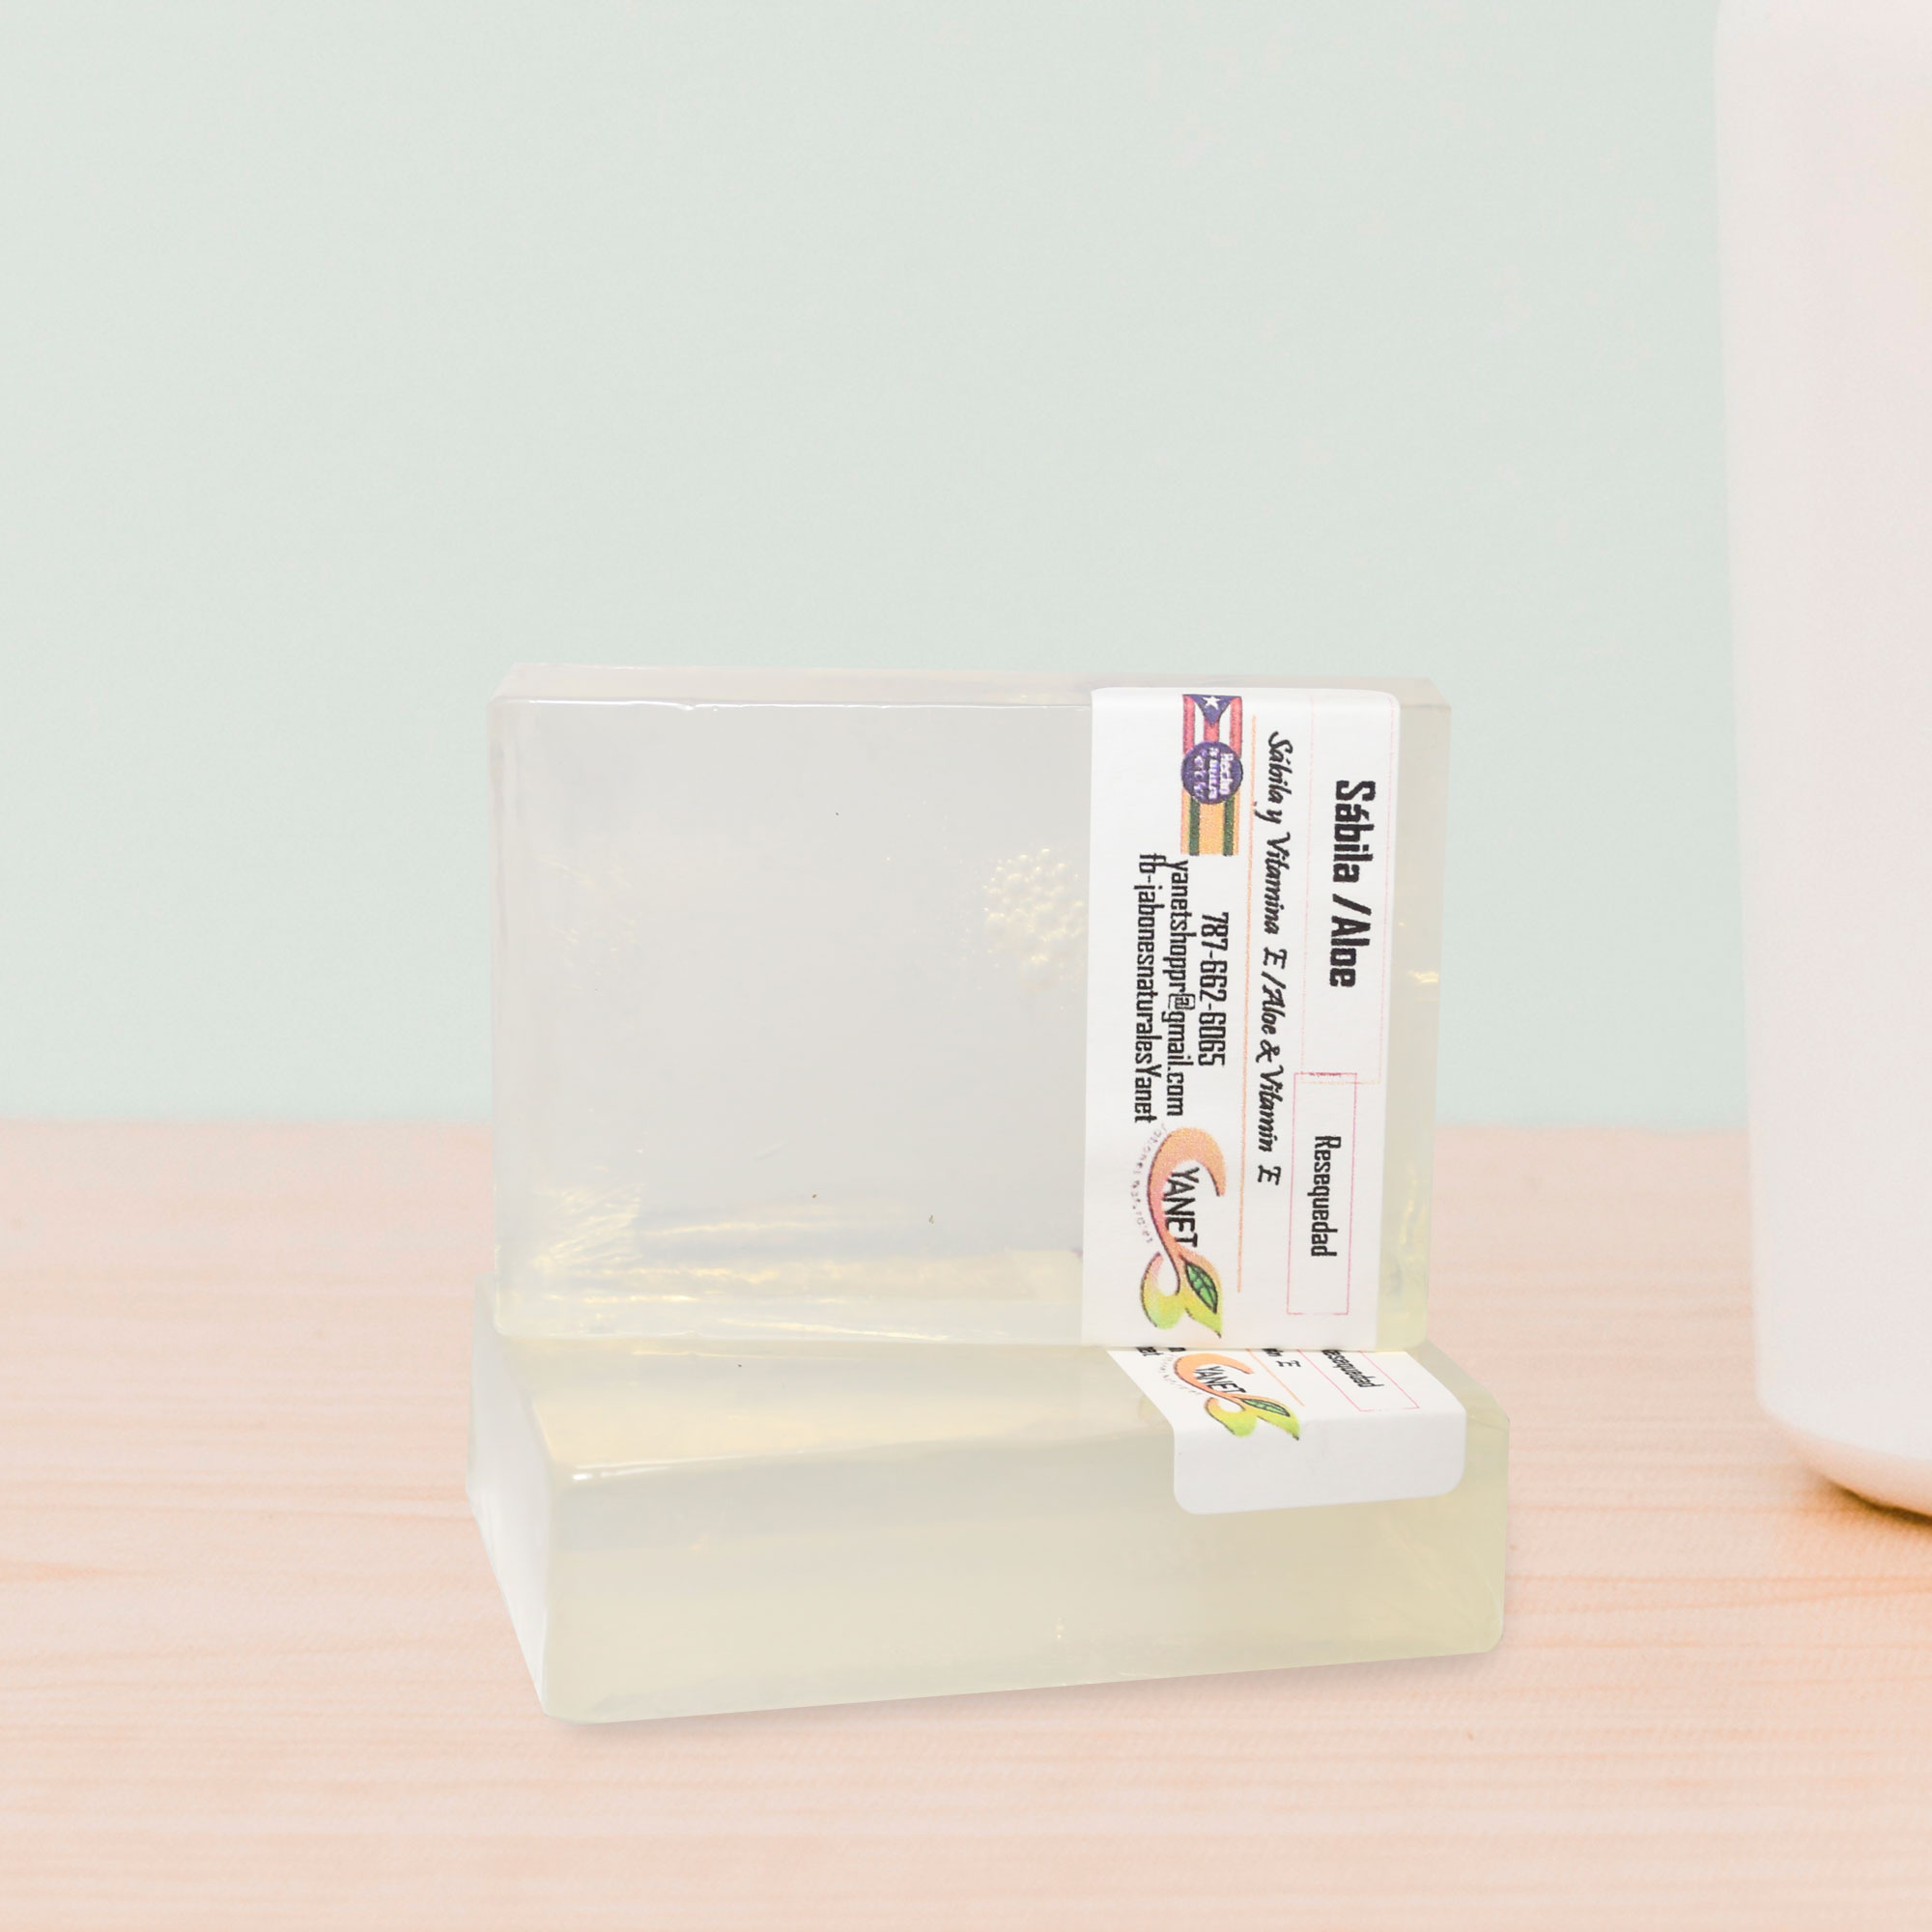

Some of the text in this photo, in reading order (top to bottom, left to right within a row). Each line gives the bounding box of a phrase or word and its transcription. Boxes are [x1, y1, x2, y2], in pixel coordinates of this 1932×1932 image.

[1267, 730, 1294, 806] Sábila
[1255, 801, 1283, 825] y
[1264, 831, 1292, 936] Vitamina
[1328, 779, 1377, 988] Sábila /Aloe
[1133, 853, 1168, 1124] fb-jabonesnaturalesYanet
[1160, 859, 1198, 1118] yanetshoppr@gmail.com
[1197, 911, 1230, 1067] 787-662-6065
[1262, 946, 1288, 970] E
[1255, 1038, 1281, 1065] &
[1258, 1065, 1285, 1152] Vitamin
[1162, 1166, 1201, 1249] YANET
[1257, 1164, 1282, 1186] E
[1306, 1135, 1342, 1257] Resequedad
[1194, 1365, 1248, 1394] YANET
[1321, 1350, 1384, 1388] esequedad
